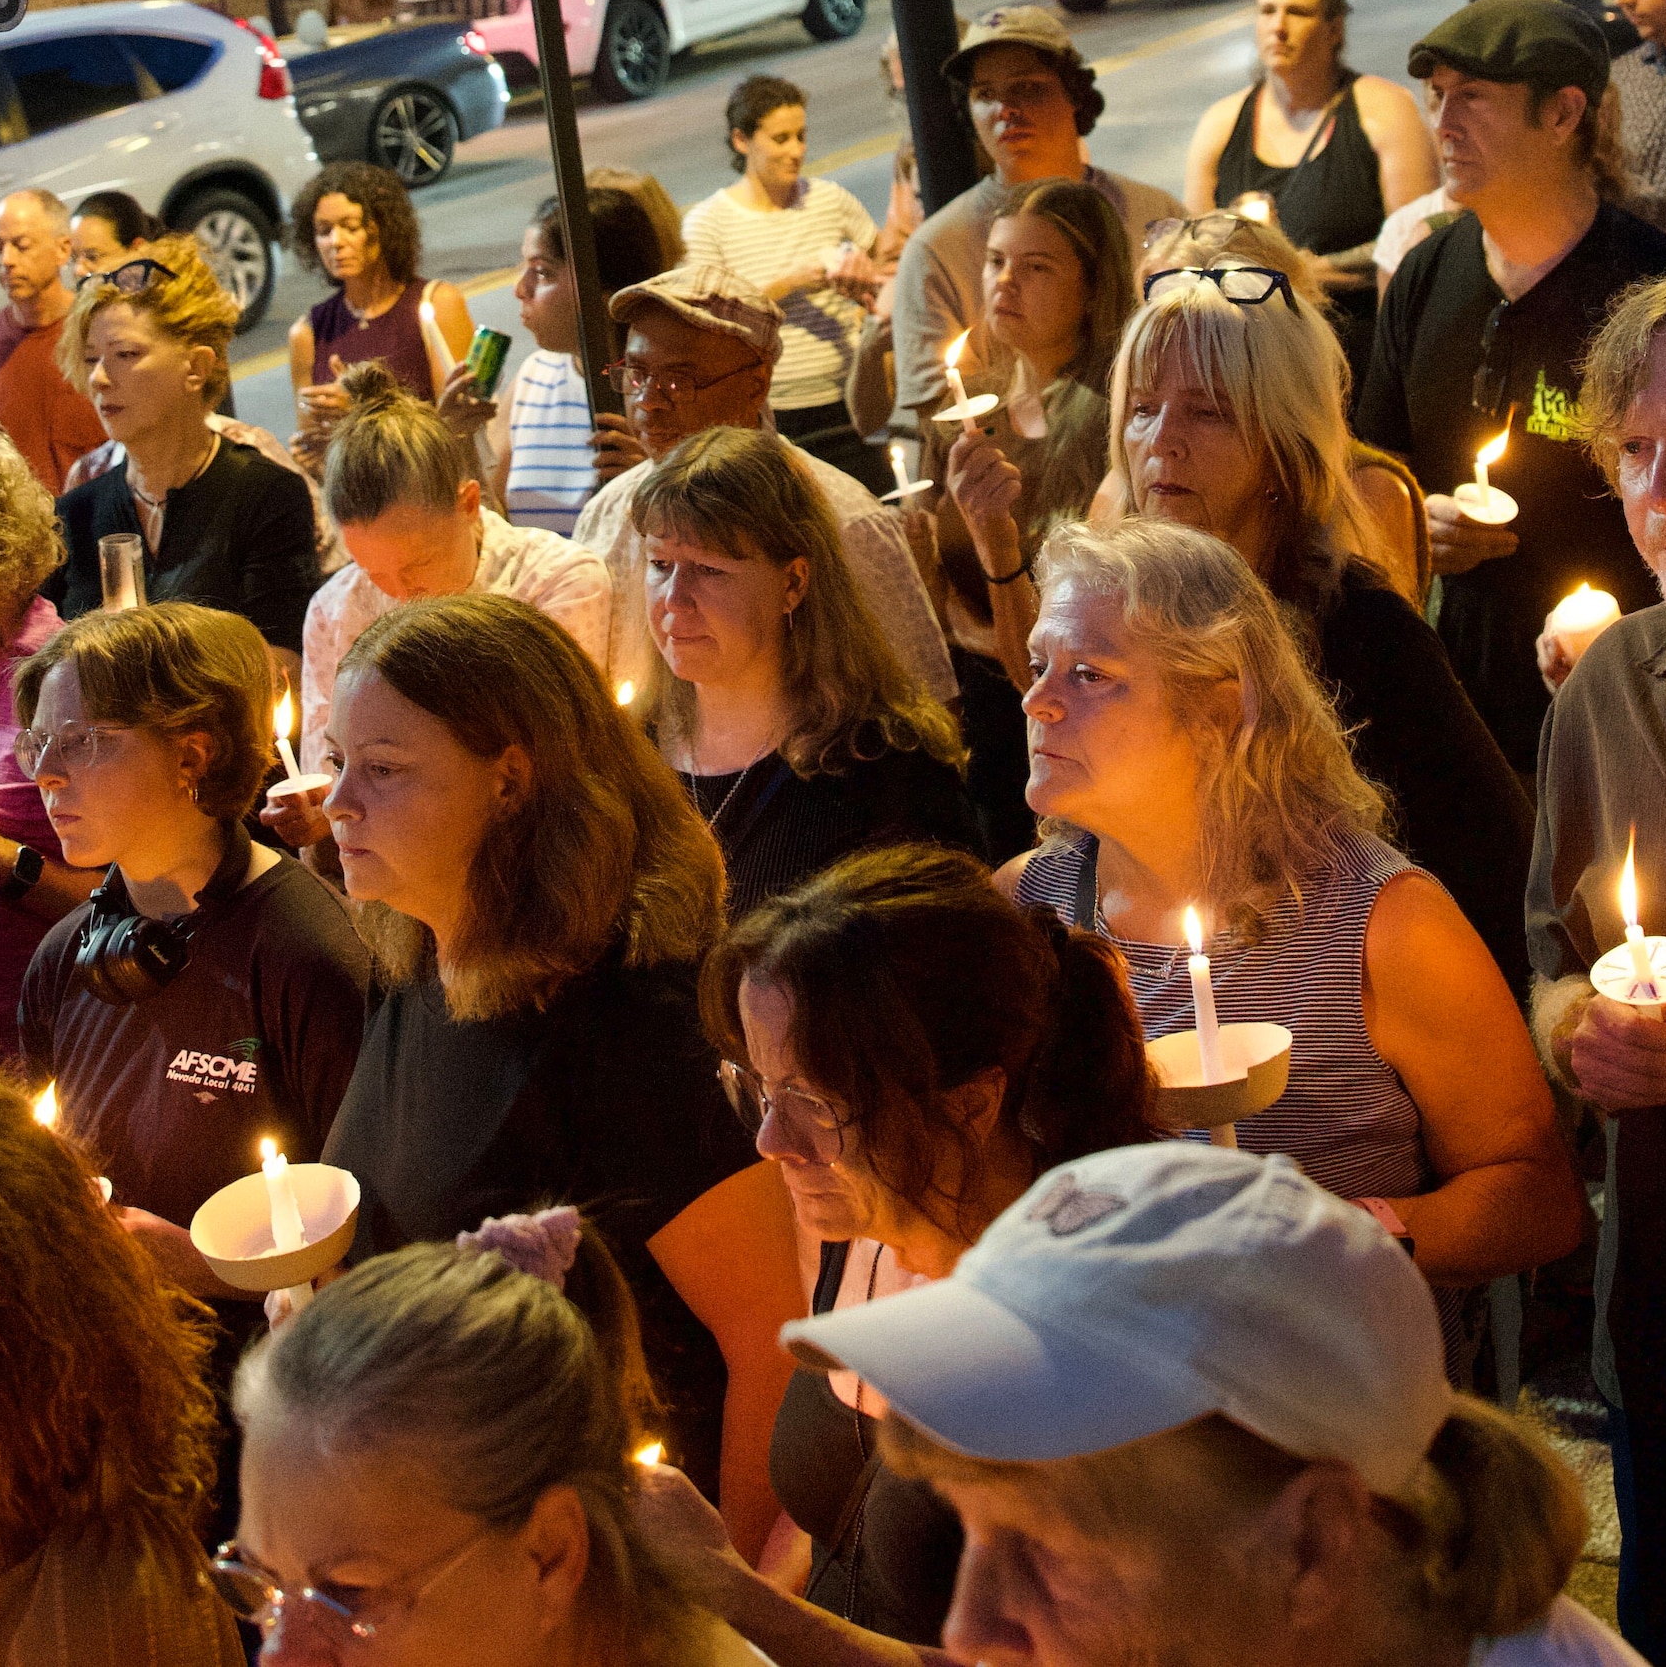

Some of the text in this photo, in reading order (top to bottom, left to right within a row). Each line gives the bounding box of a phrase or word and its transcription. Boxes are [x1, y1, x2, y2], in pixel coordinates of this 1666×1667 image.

[166, 1068, 256, 1094] Nevada Local 4041
[169, 1049, 258, 1083] AFSCME
